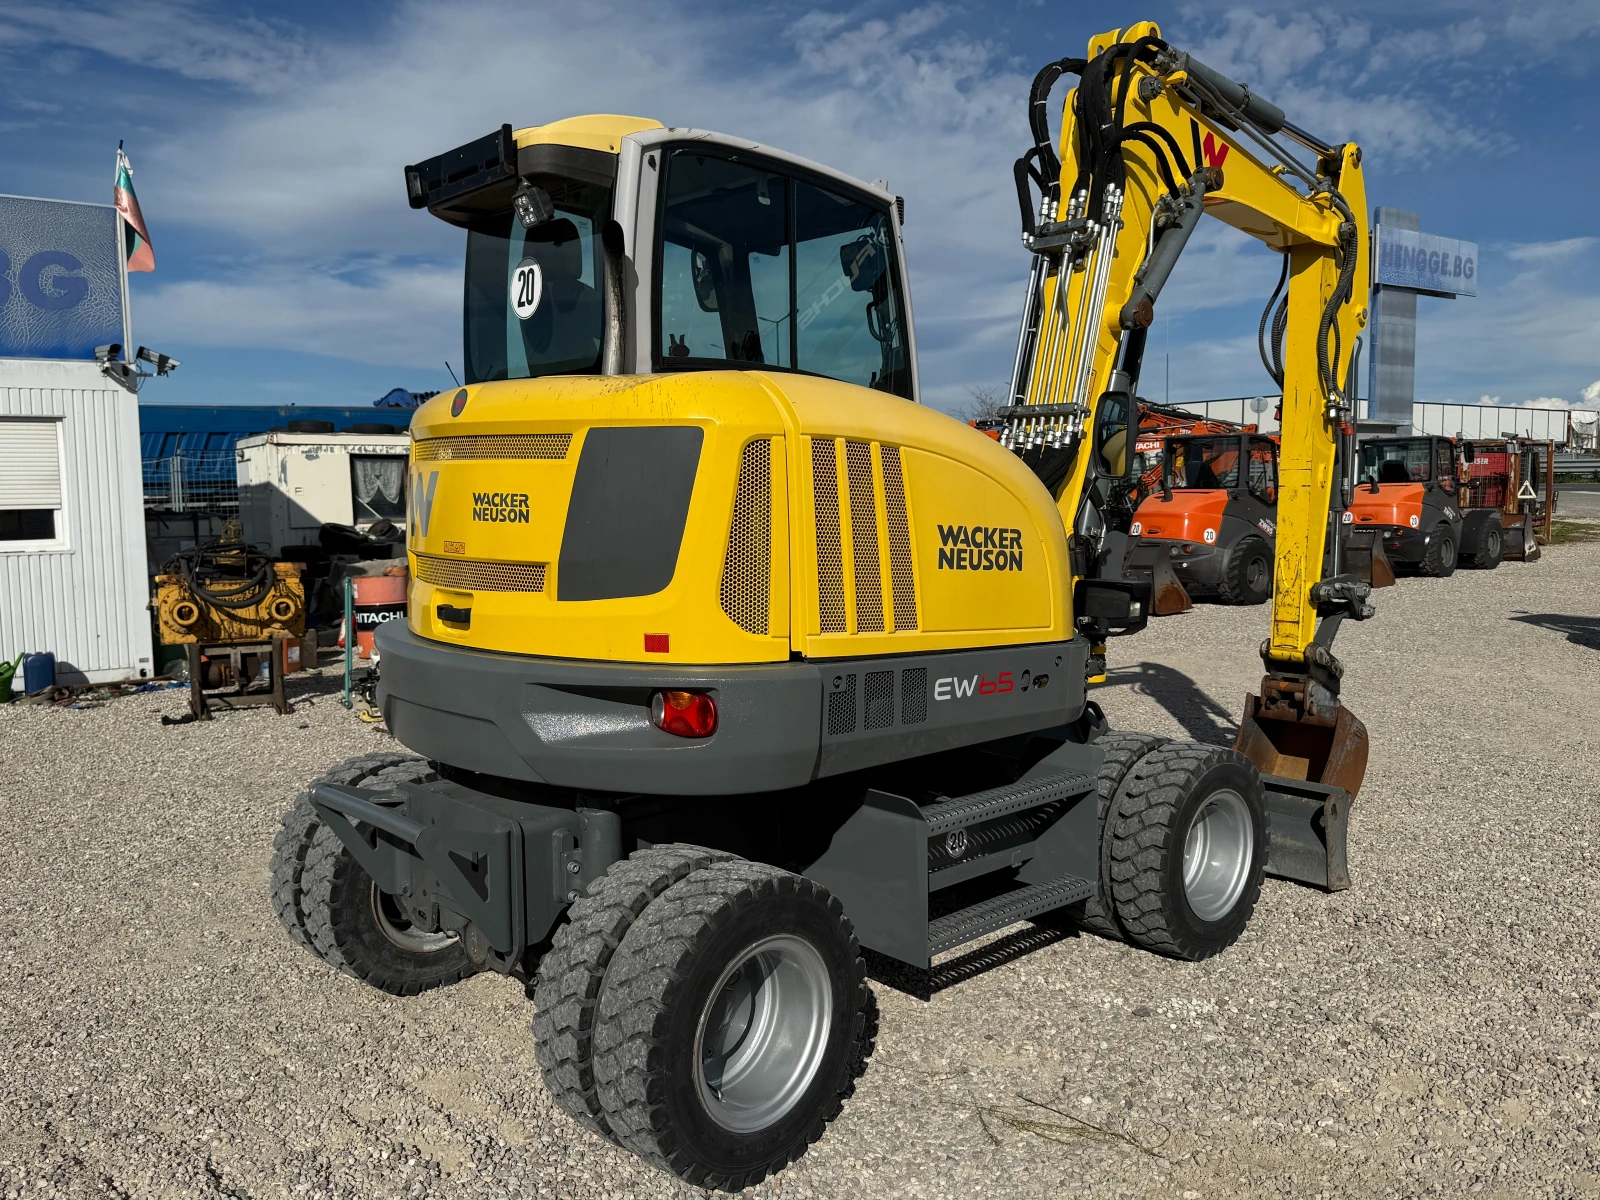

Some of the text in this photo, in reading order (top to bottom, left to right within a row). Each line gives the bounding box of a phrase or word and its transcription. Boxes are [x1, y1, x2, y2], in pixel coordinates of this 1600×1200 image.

[517, 267, 534, 308] 20
[472, 492, 530, 508] WACKER
[472, 508, 530, 524] NEUSON
[937, 524, 1022, 550] WACKER
[938, 547, 1023, 572] NEUSON
[355, 611, 404, 624] HITACHI
[934, 671, 1015, 701] EW65
[950, 830, 964, 850] 20
